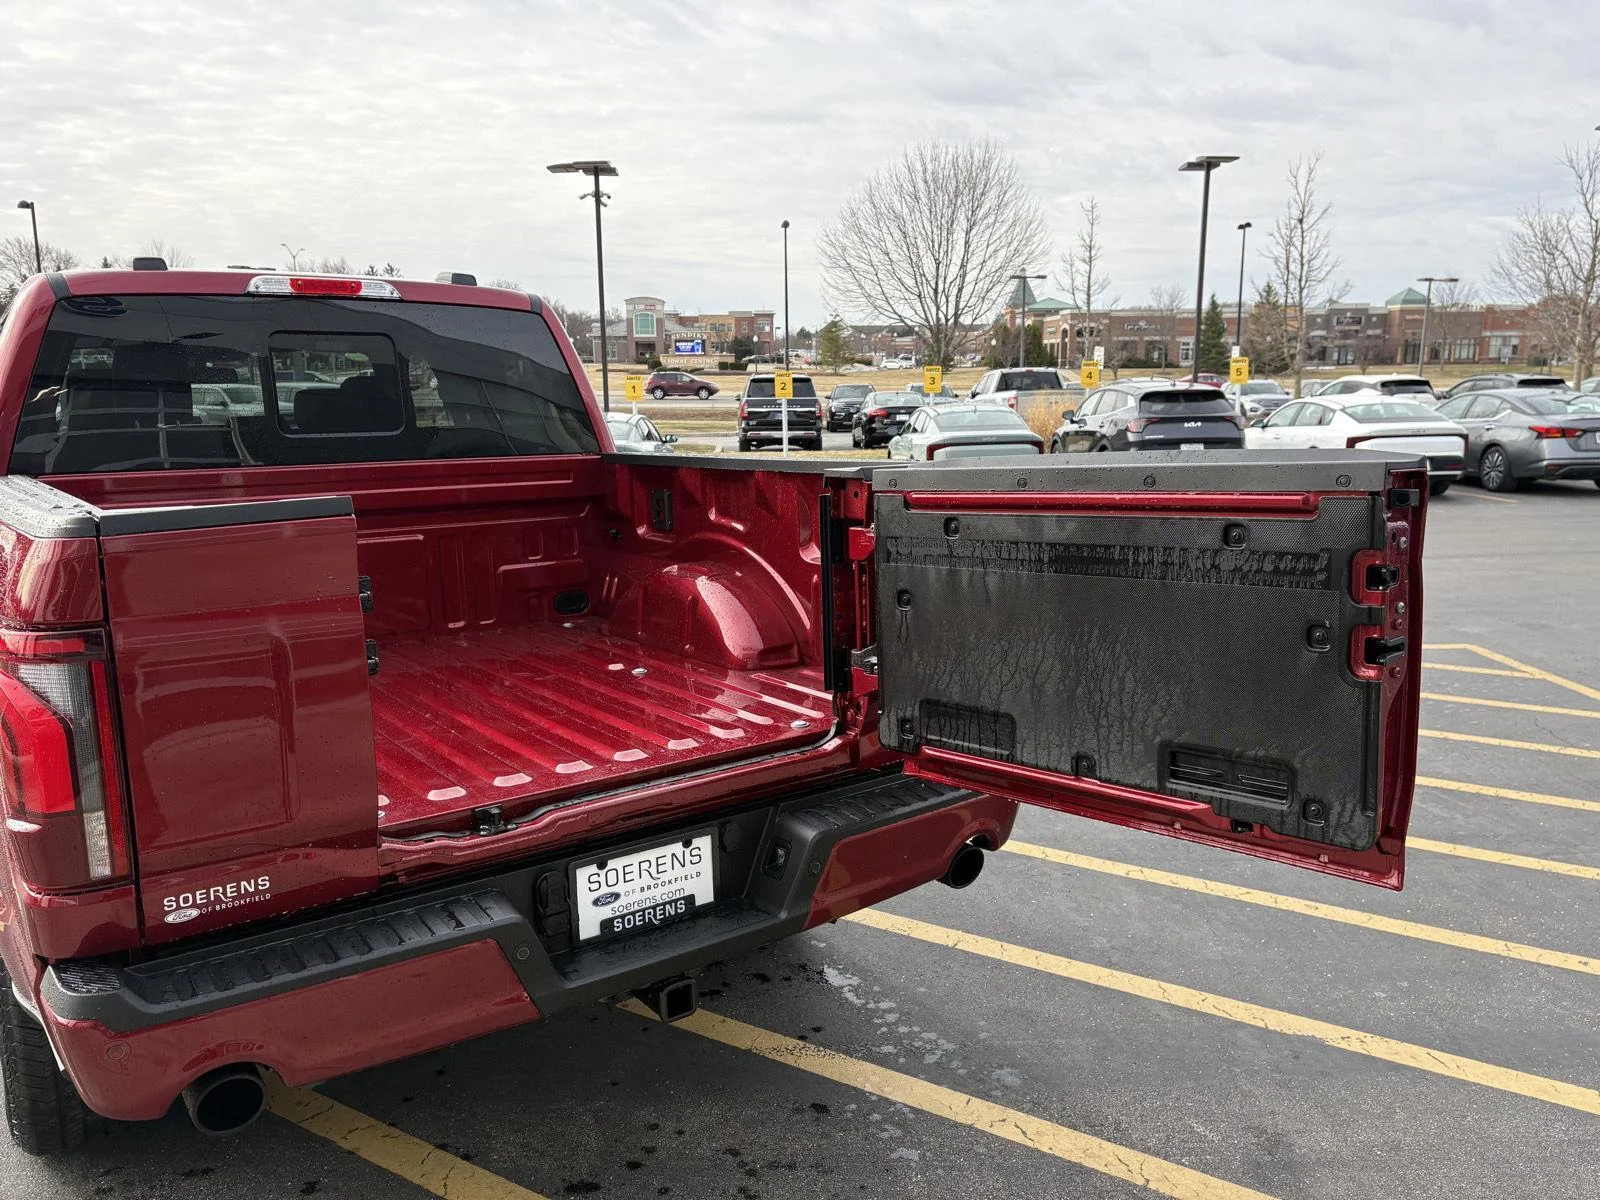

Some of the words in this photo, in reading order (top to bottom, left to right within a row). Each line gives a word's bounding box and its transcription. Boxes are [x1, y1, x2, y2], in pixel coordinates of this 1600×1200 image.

[929, 376, 936, 386] 3
[1086, 371, 1092, 380] 4
[1235, 367, 1242, 377] 5
[631, 384, 636, 394] 1
[780, 382, 787, 391] 2
[588, 847, 702, 892] SOERENS
[163, 876, 270, 911] SOERENS
[624, 889, 638, 898] OF
[640, 871, 702, 894] BROOKFIELD
[201, 906, 213, 914] OF
[215, 893, 271, 912] BROOKFIELD
[611, 886, 686, 916] soerens.com
[613, 899, 686, 932] SOERENS
